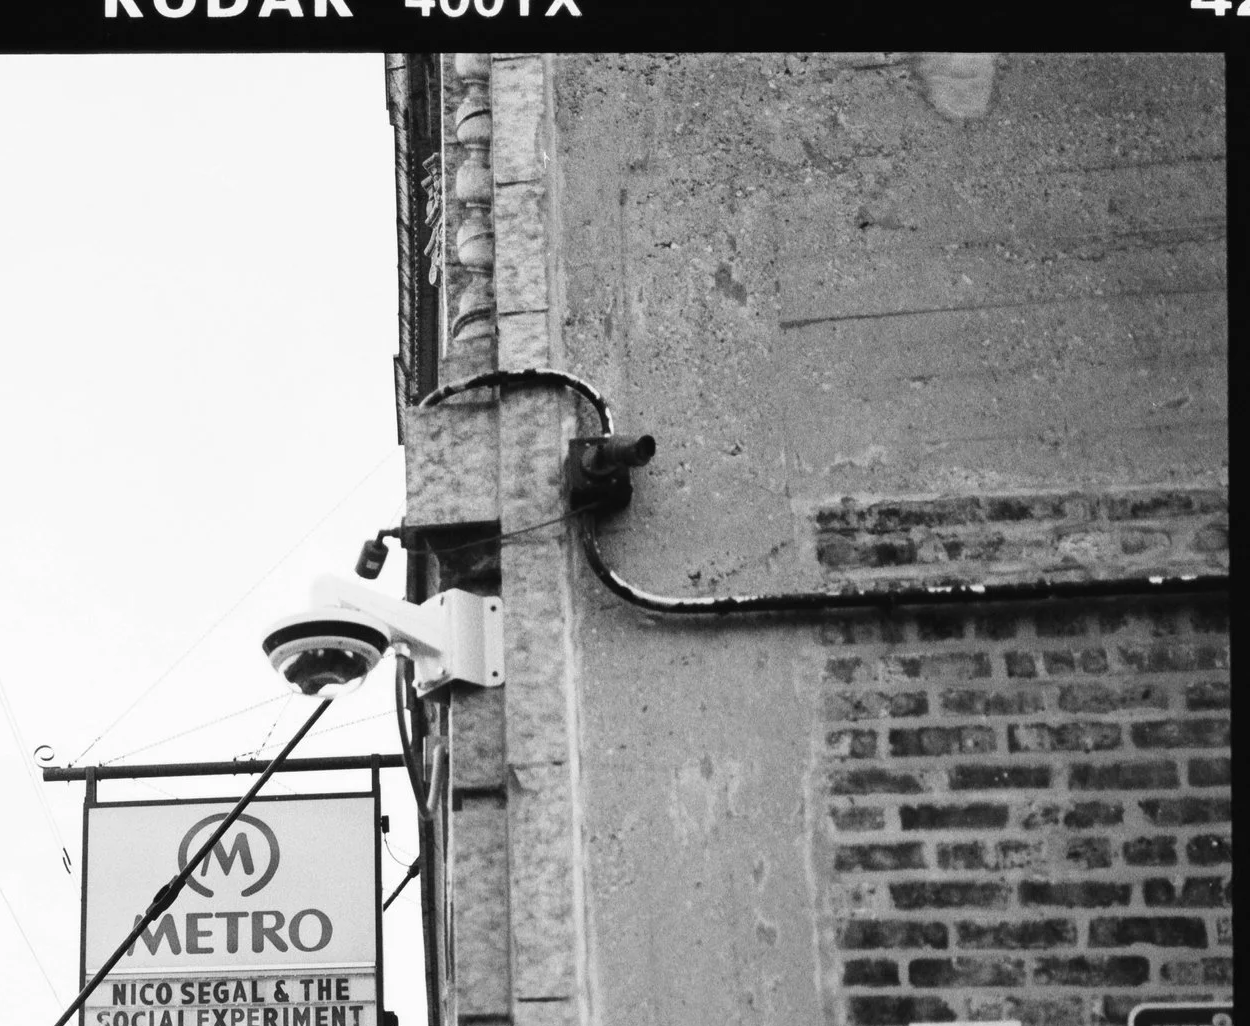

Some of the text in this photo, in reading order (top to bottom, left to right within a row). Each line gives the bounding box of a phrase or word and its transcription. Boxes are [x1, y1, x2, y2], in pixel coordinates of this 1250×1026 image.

[126, 908, 334, 956] METRO
[112, 978, 350, 1006] NICO SEGAL & THE
